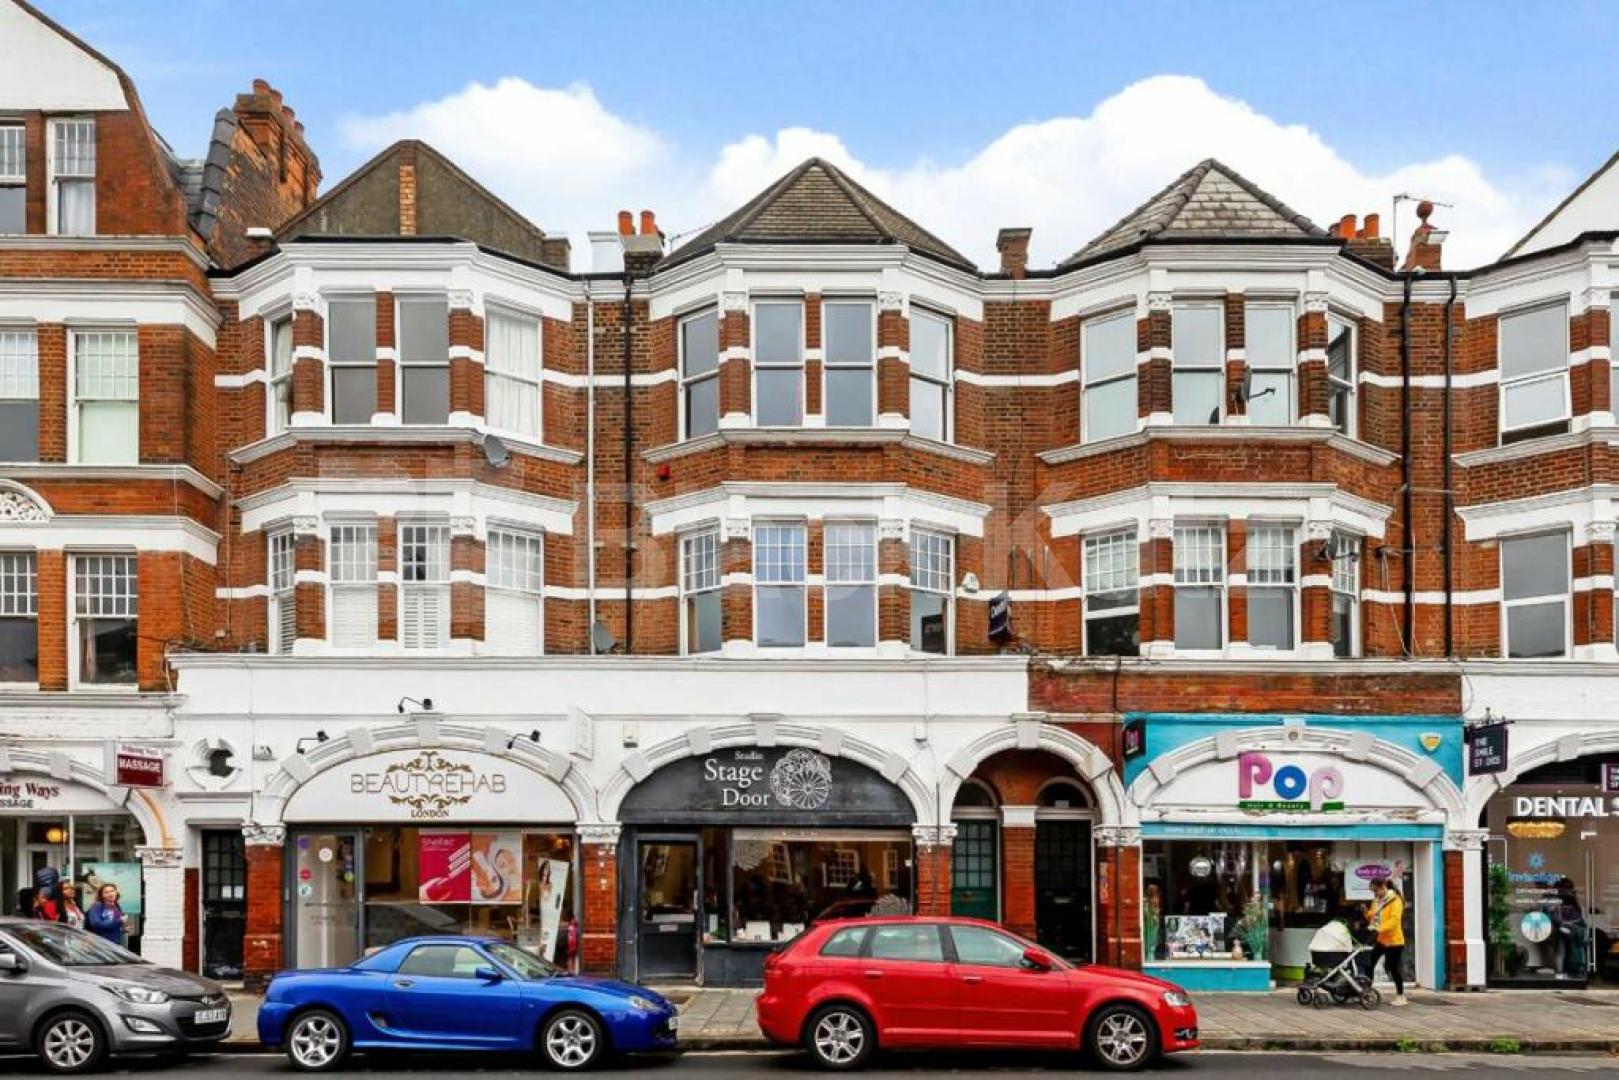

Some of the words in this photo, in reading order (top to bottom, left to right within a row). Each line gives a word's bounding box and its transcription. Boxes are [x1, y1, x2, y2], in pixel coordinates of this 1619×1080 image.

[119, 758, 160, 772] MASSAGE
[704, 758, 763, 788] Stage
[25, 782, 59, 800] Ways
[722, 788, 770, 806] Door
[411, 809, 450, 818] LONDON
[1515, 796, 1609, 816] DENTAL
